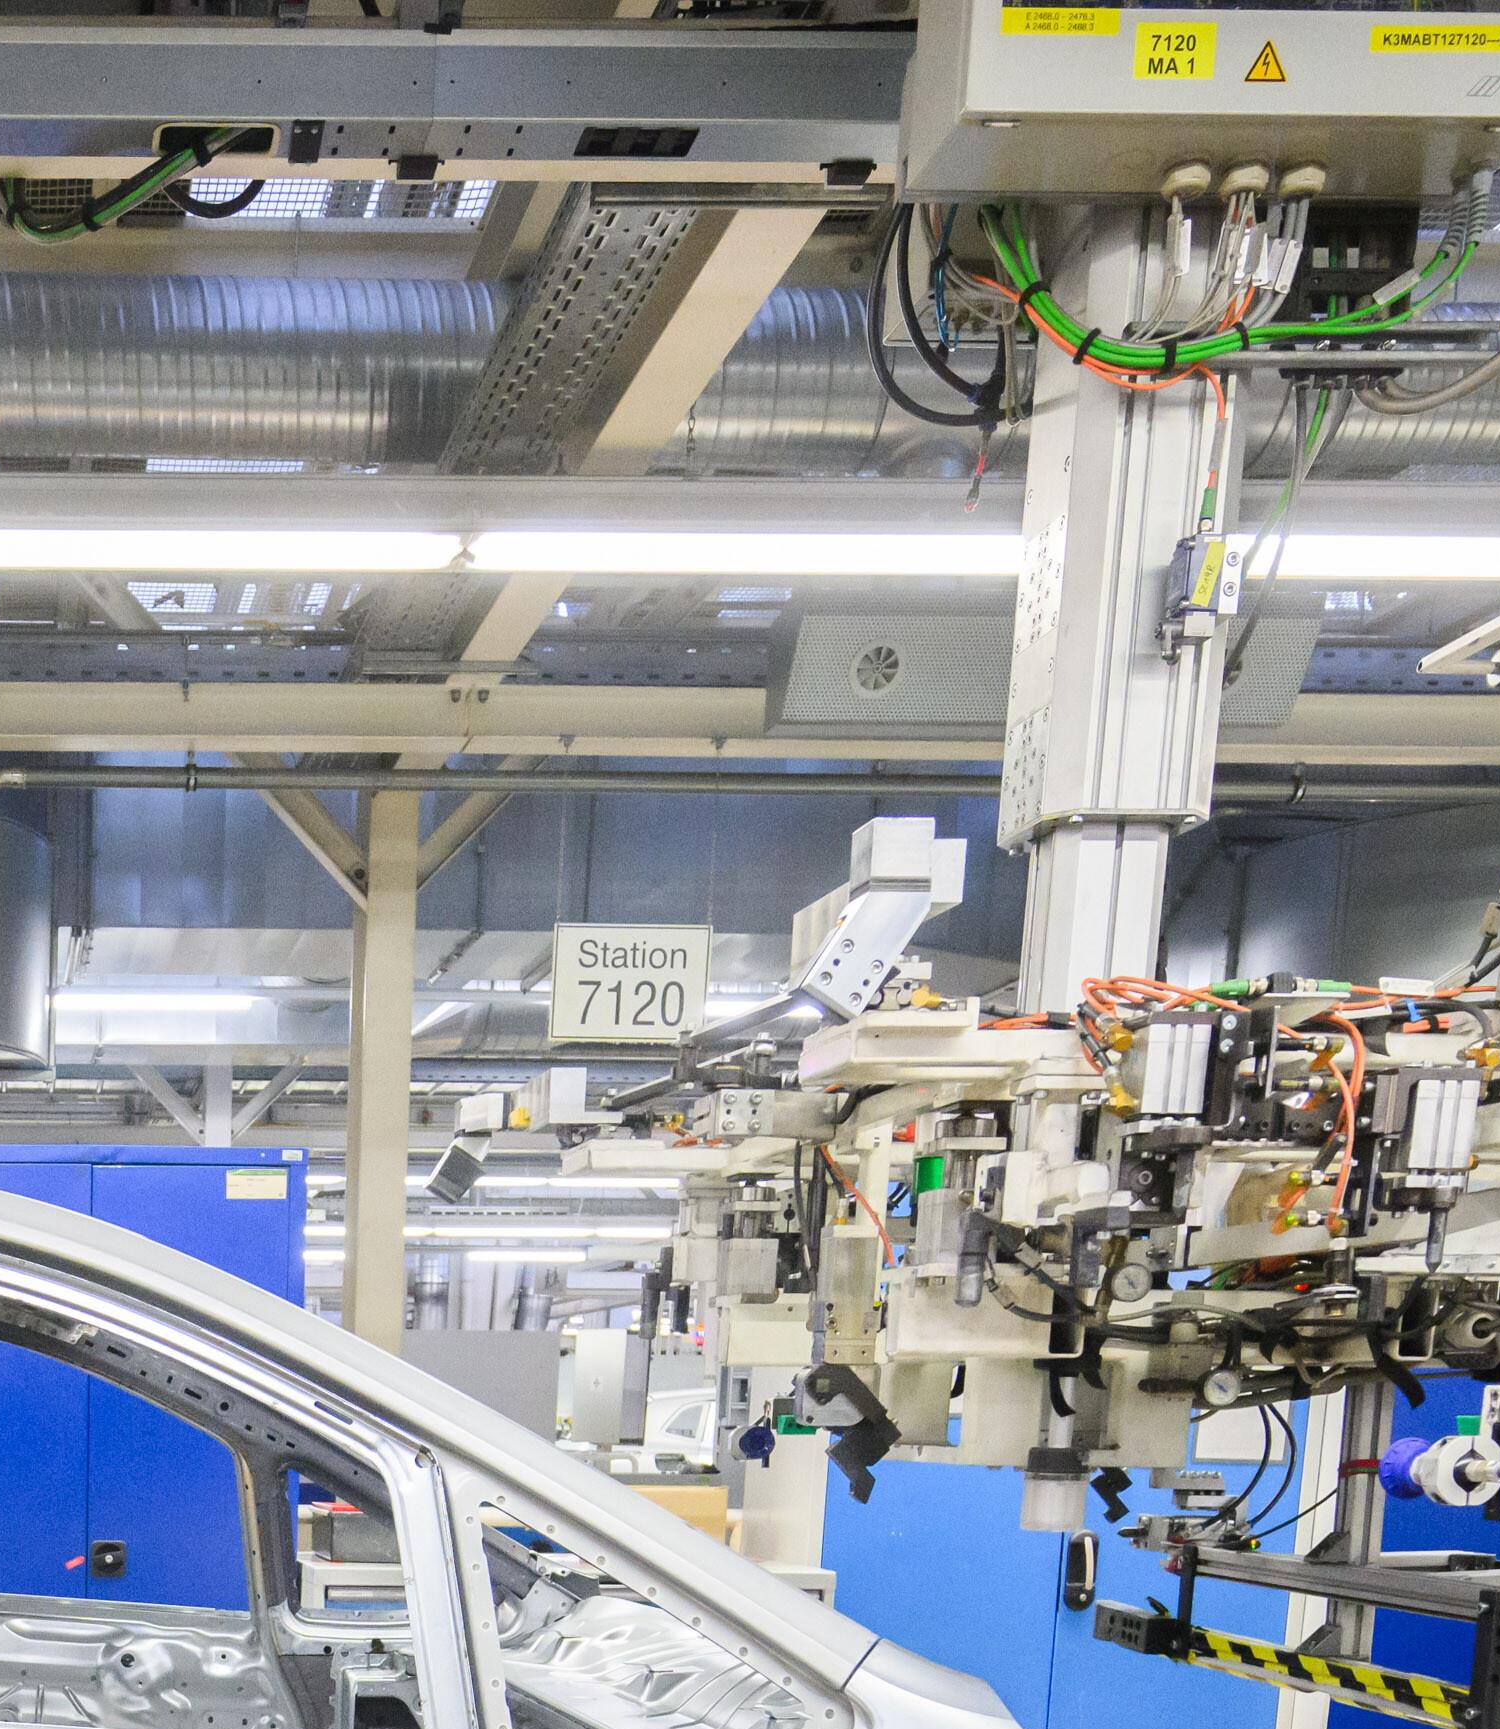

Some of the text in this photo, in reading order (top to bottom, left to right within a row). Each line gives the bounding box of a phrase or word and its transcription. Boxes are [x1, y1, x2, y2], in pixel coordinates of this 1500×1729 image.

[1151, 34, 1197, 52] 7120
[1147, 57, 1195, 74] MA 1
[578, 939, 687, 969] Station
[578, 980, 685, 1027] 7120
